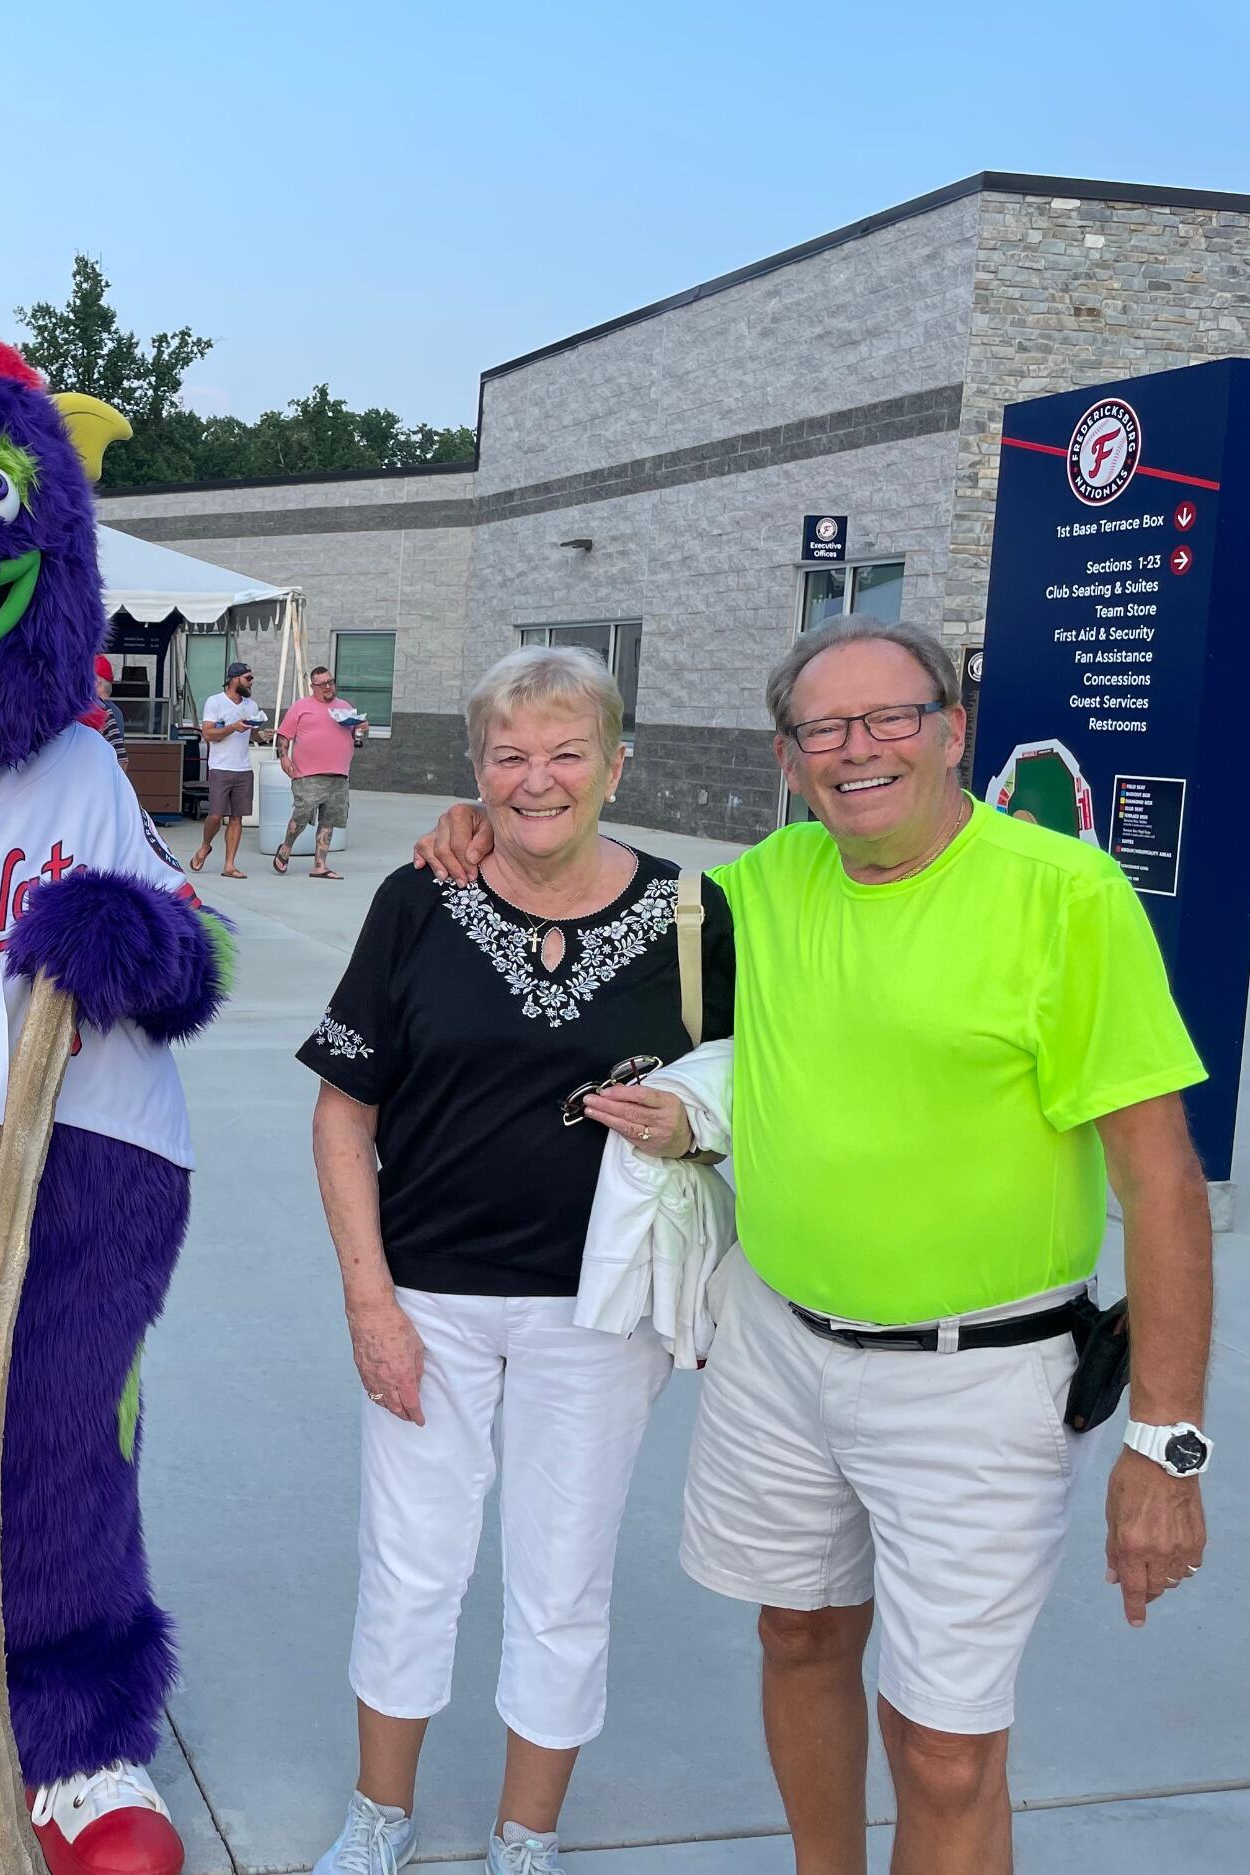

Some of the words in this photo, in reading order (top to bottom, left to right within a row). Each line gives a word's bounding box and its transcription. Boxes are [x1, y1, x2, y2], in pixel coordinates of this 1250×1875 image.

[1072, 405, 1136, 461] FREDERICKSBURG
[1088, 426, 1122, 479] F
[1075, 469, 1128, 499] NATIONALS
[1056, 526, 1071, 538] 1st
[1073, 523, 1098, 536] Base
[1099, 519, 1140, 532] Terrace
[1143, 514, 1165, 528] Box
[810, 541, 842, 549] Executive
[813, 550, 837, 558] Offices
[1086, 558, 1132, 574] Sections
[1138, 554, 1161, 569] 1-23
[1046, 585, 1070, 599] Club
[1072, 582, 1111, 598] Seating
[1114, 581, 1123, 594] &
[1125, 578, 1159, 593] Suites
[1095, 605, 1124, 618] Team
[1126, 603, 1157, 616] Store
[1054, 628, 1076, 642] First
[1078, 627, 1096, 640] Aid
[1098, 627, 1106, 640] &
[1109, 624, 1155, 642] Security
[1075, 650, 1093, 663] Fan
[1095, 648, 1153, 662] Assistance
[1083, 671, 1151, 686] Concessions
[1069, 694, 1101, 708] Guest
[1103, 694, 1149, 708] Services
[1088, 717, 1147, 732] Restrooms
